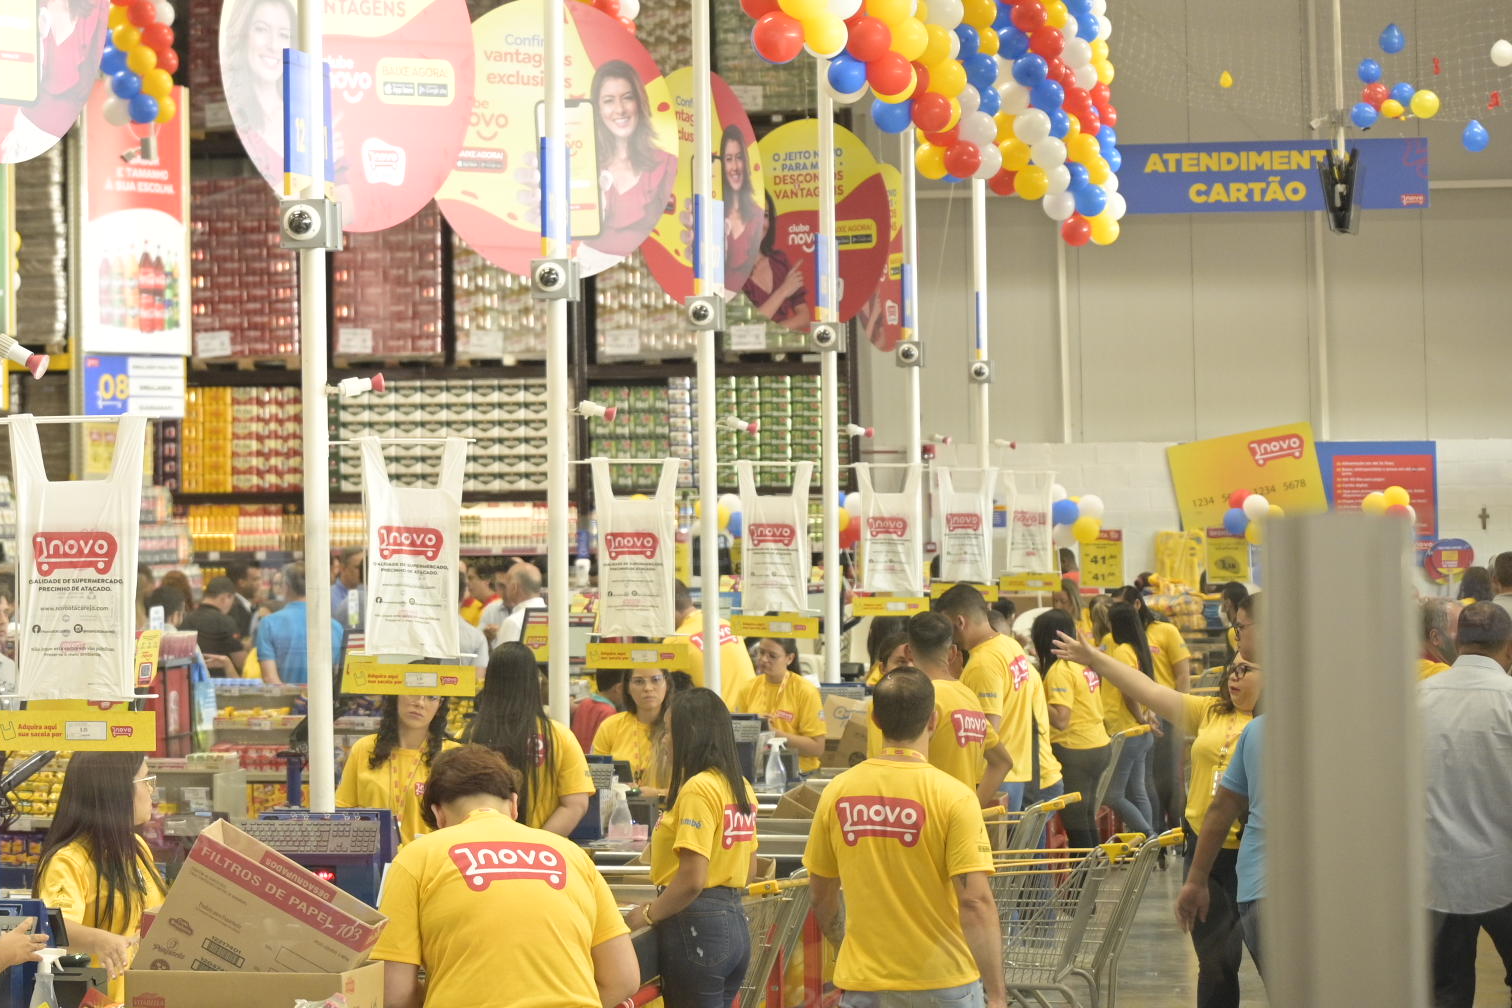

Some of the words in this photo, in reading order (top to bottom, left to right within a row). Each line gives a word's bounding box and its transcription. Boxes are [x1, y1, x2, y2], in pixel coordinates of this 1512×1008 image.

[782, 150, 811, 162] JEITO
[781, 162, 808, 172] PARA
[1188, 176, 1307, 204] CARTÃO
[99, 373, 130, 400] 08
[1261, 437, 1300, 455] novo
[1192, 495, 1215, 509] 1234
[1283, 478, 1307, 491] 5678
[49, 539, 109, 555] novo
[388, 533, 437, 546] novo
[617, 536, 653, 548] novo
[17, 723, 41, 731] Adquira
[42, 723, 58, 732] aqui
[30, 730, 53, 738] sacola
[853, 803, 918, 825] novo
[476, 848, 558, 867] novo
[200, 845, 263, 888] FILTROS
[265, 881, 286, 901] DE
[289, 894, 335, 930] PAPEL
[337, 920, 364, 943] 103
